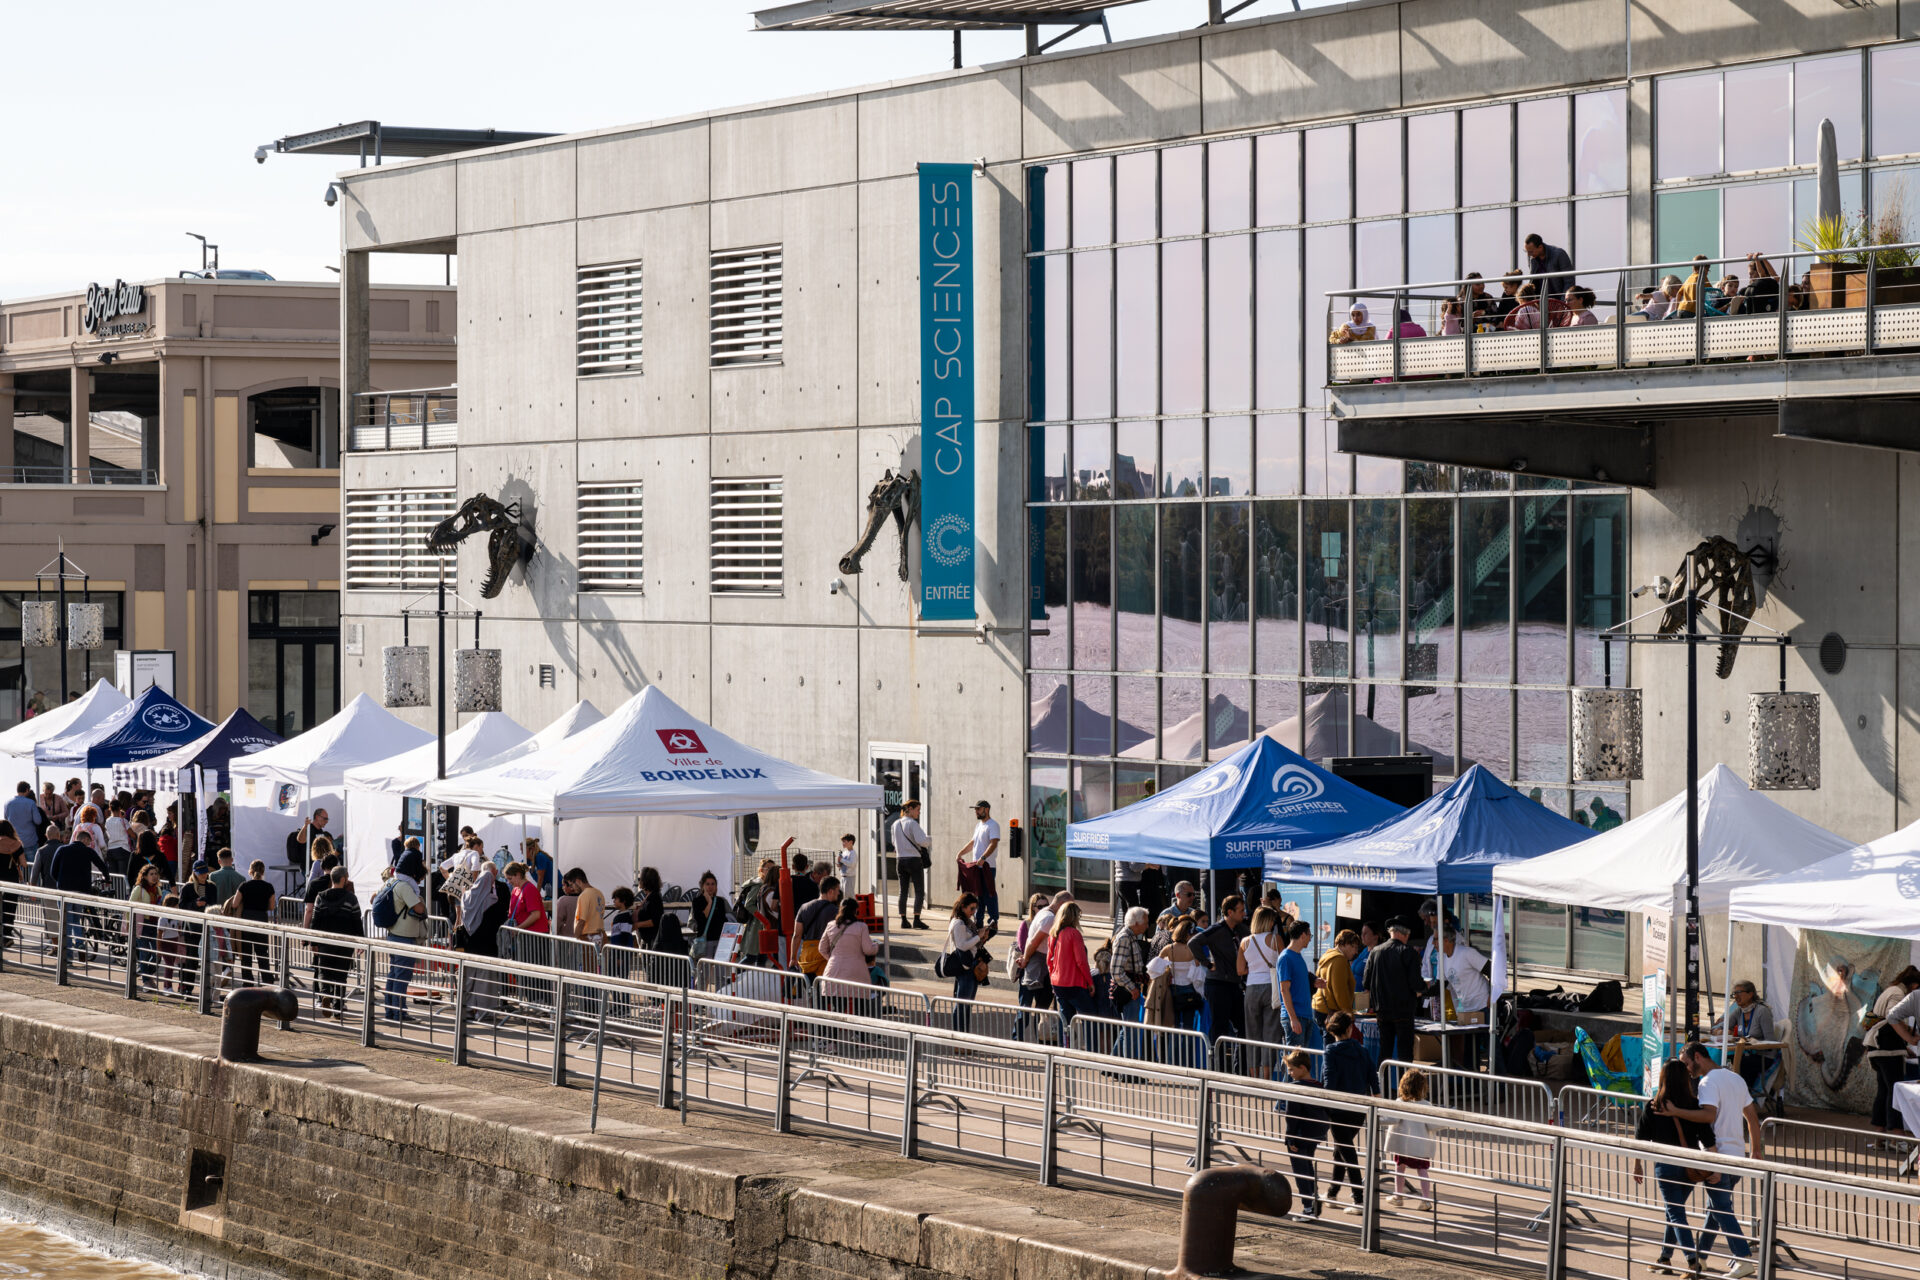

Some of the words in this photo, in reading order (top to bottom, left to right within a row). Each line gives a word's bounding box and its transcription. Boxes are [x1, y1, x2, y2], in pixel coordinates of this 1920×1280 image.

[932, 181, 962, 380] SCIENCES
[935, 397, 963, 476] CAP
[925, 582, 971, 601] ENTRÉE
[230, 735, 279, 746] HUÎTRES
[666, 757, 702, 767] Ville
[704, 756, 725, 767] de
[639, 767, 769, 782] BORDEAUX
[1268, 801, 1345, 816] SURFRIDER
[1073, 831, 1110, 844] SURFRIDER
[1225, 838, 1292, 853] SURFRIDER
[1225, 851, 1263, 860] FOUNDATIO
